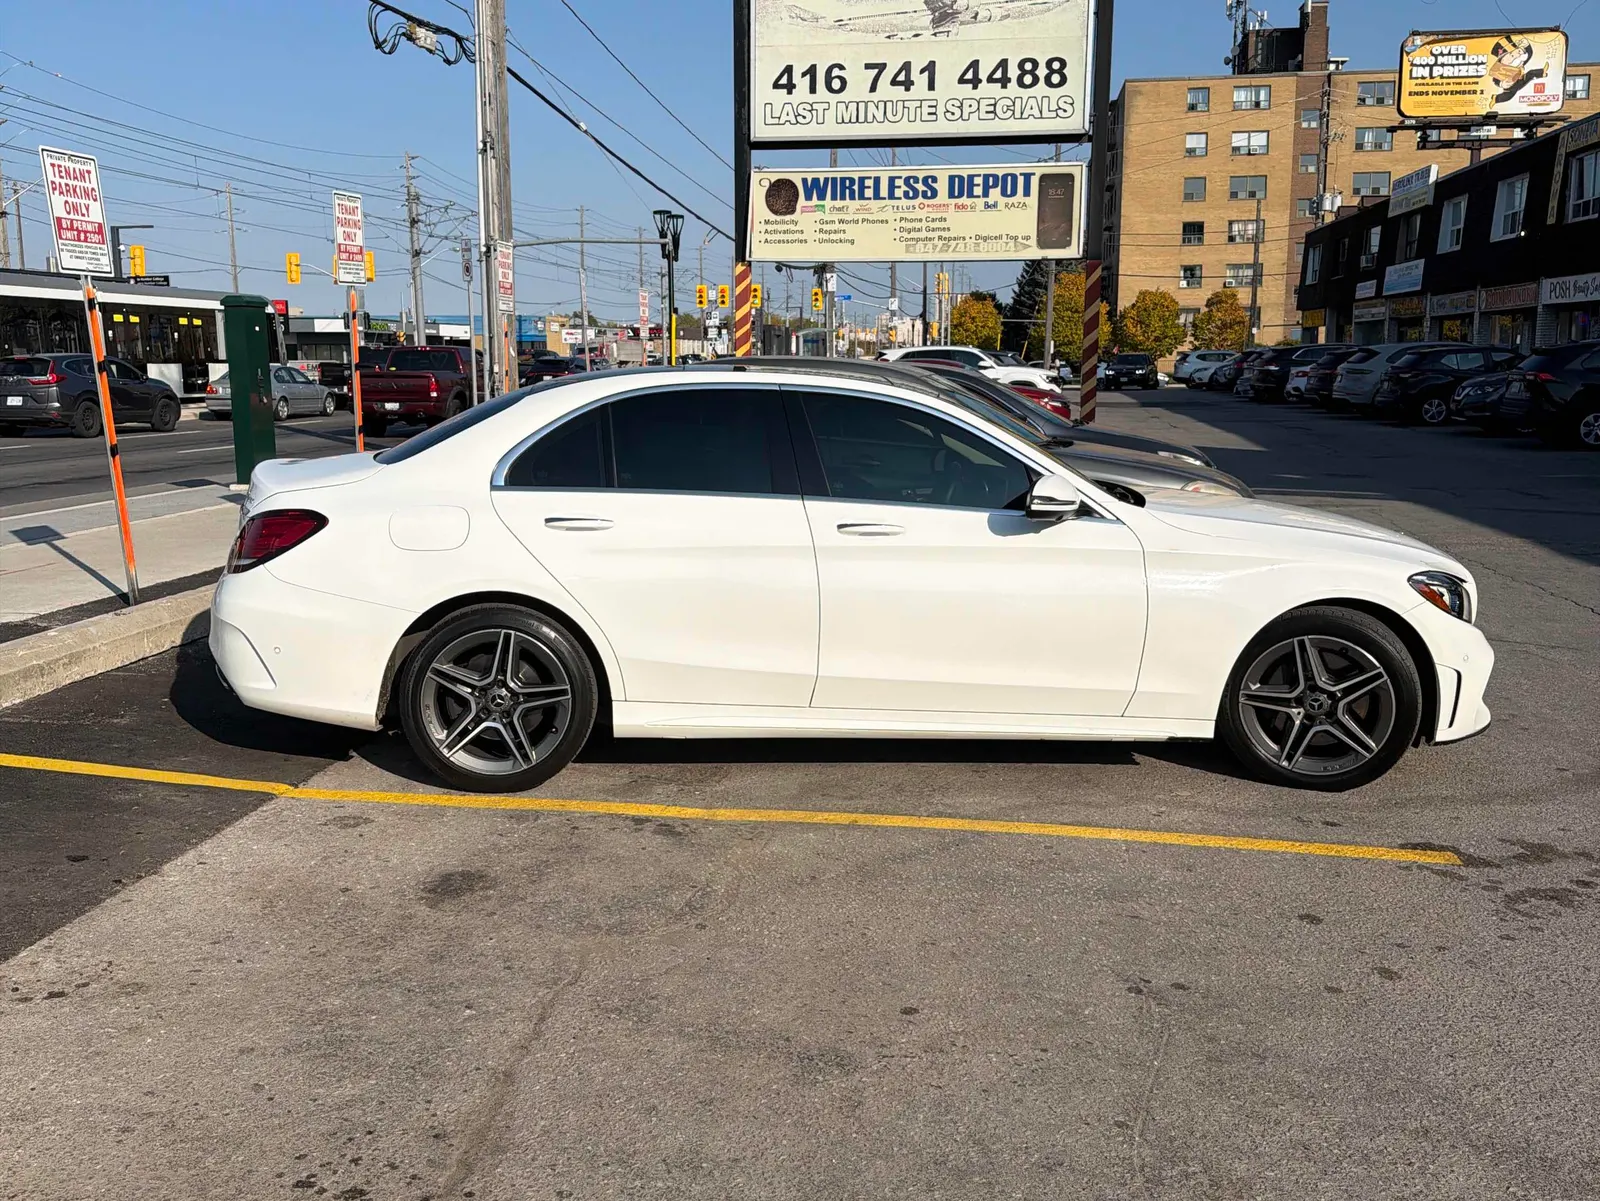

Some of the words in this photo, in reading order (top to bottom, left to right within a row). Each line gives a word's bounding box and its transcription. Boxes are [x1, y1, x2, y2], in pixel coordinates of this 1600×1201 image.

[1431, 45, 1466, 54] OVER
[1437, 54, 1488, 64] MILLION
[772, 63, 848, 96] 416
[864, 60, 937, 93] 741
[957, 56, 1068, 90] 4488
[1412, 66, 1430, 78] IN
[1432, 64, 1487, 77] PRIZES
[764, 102, 829, 126] LAST
[836, 100, 938, 124] MINUTE
[944, 96, 1075, 121] SPECIALS
[46, 153, 66, 162] PRIVATE
[68, 156, 92, 166] PROPERTY
[50, 162, 92, 184] TENANT
[50, 180, 98, 202] PARKING
[801, 175, 938, 202] WIRELESS
[948, 172, 1036, 199] DEPOT
[64, 200, 90, 218] ONLY
[337, 203, 359, 217] TENANT
[984, 201, 998, 209] Bell
[1004, 202, 1028, 210] RAZA
[61, 218, 70, 229] BY
[73, 220, 98, 232] PERMIT
[336, 216, 361, 230] PARKING
[61, 230, 78, 240] UNIT
[80, 232, 85, 240] #
[87, 233, 102, 244] 2501
[343, 230, 357, 243] ONLY
[818, 238, 855, 246] Unlocking
[899, 236, 936, 244] Computer
[974, 234, 1003, 242] Digicell
[347, 245, 360, 253] PERMIT
[1550, 280, 1570, 300] POSH
